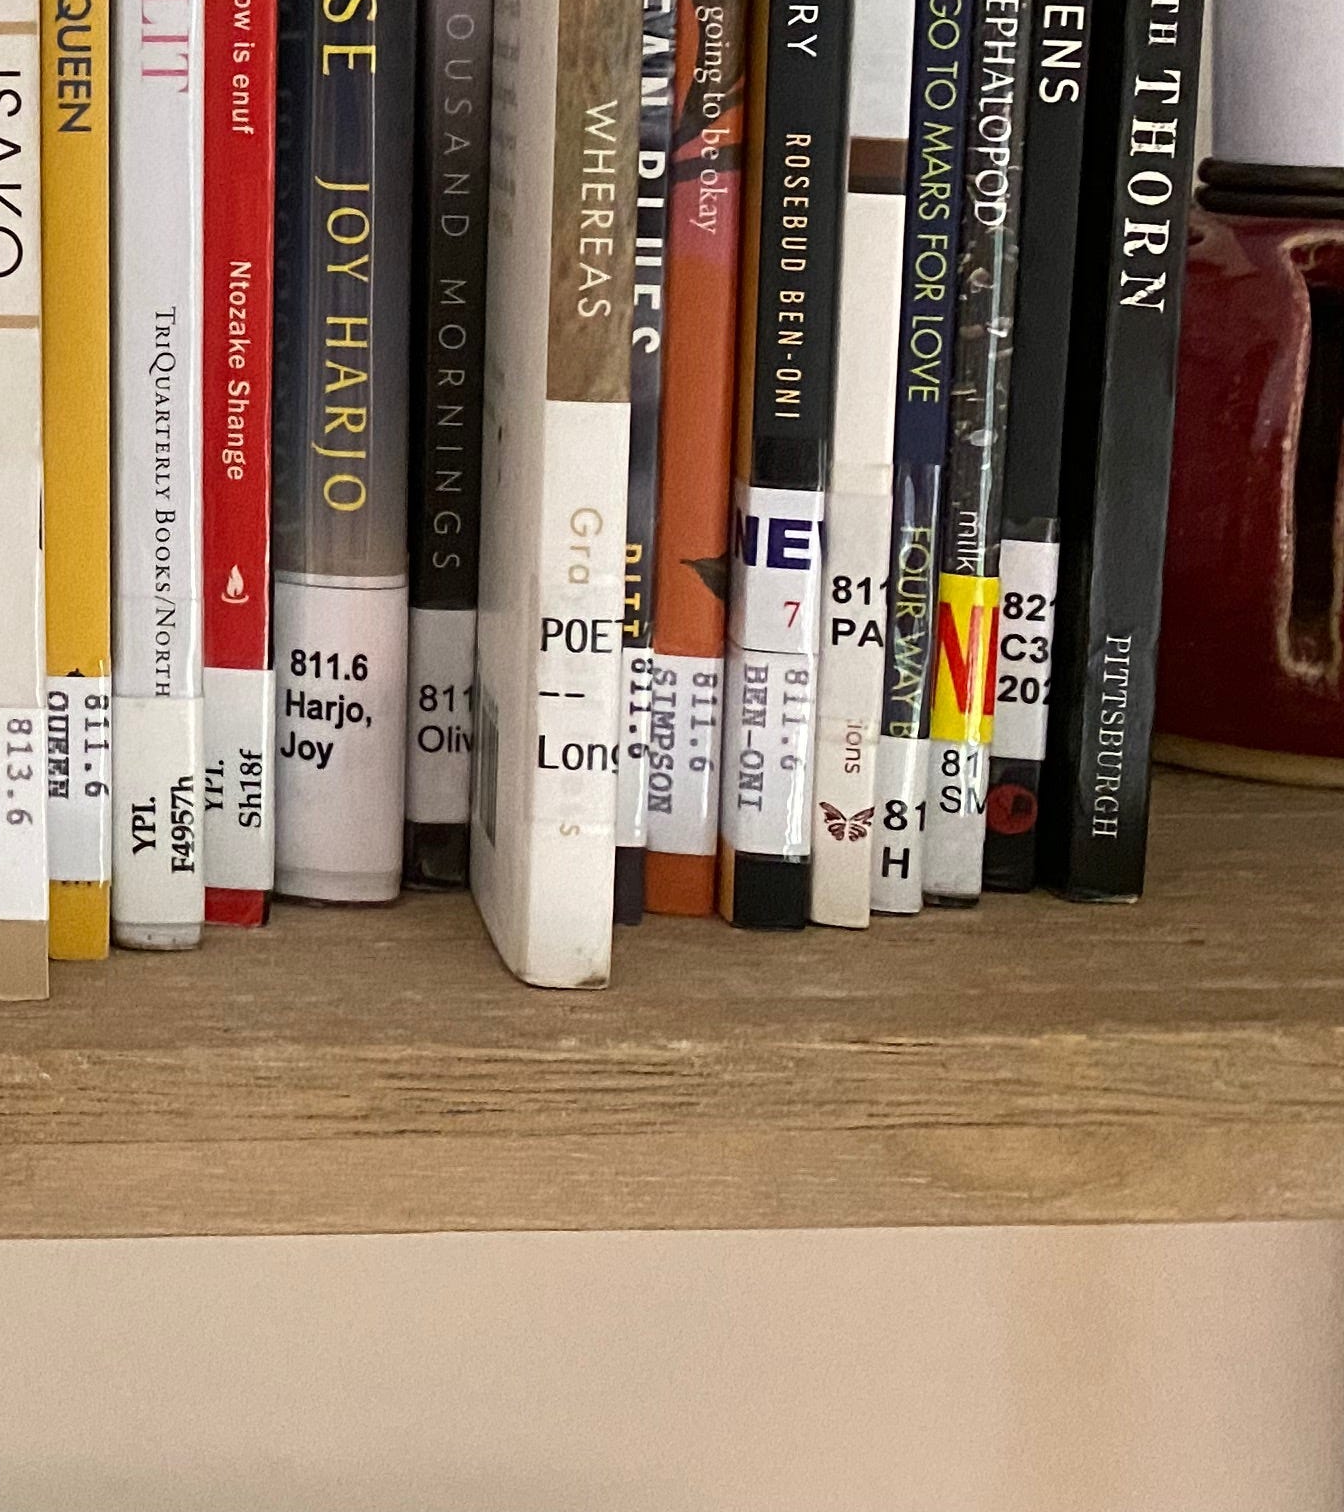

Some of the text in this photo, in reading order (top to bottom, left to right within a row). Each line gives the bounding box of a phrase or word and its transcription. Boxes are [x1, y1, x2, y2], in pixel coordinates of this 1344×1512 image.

[692, 2, 730, 85] going
[701, 91, 729, 120] to
[922, 61, 959, 111] TO
[699, 126, 730, 162] be
[917, 120, 955, 222] MARS
[688, 167, 729, 236] okay
[1119, 67, 1181, 315] THORN
[913, 233, 949, 303] FOR
[221, 260, 253, 482] Ntozake Shange
[311, 175, 371, 513] JOY HARJO
[907, 313, 944, 404] LOVE
[783, 600, 802, 629] 7
[290, 649, 369, 682] 811.6
[171, 775, 195, 875] F4957h
